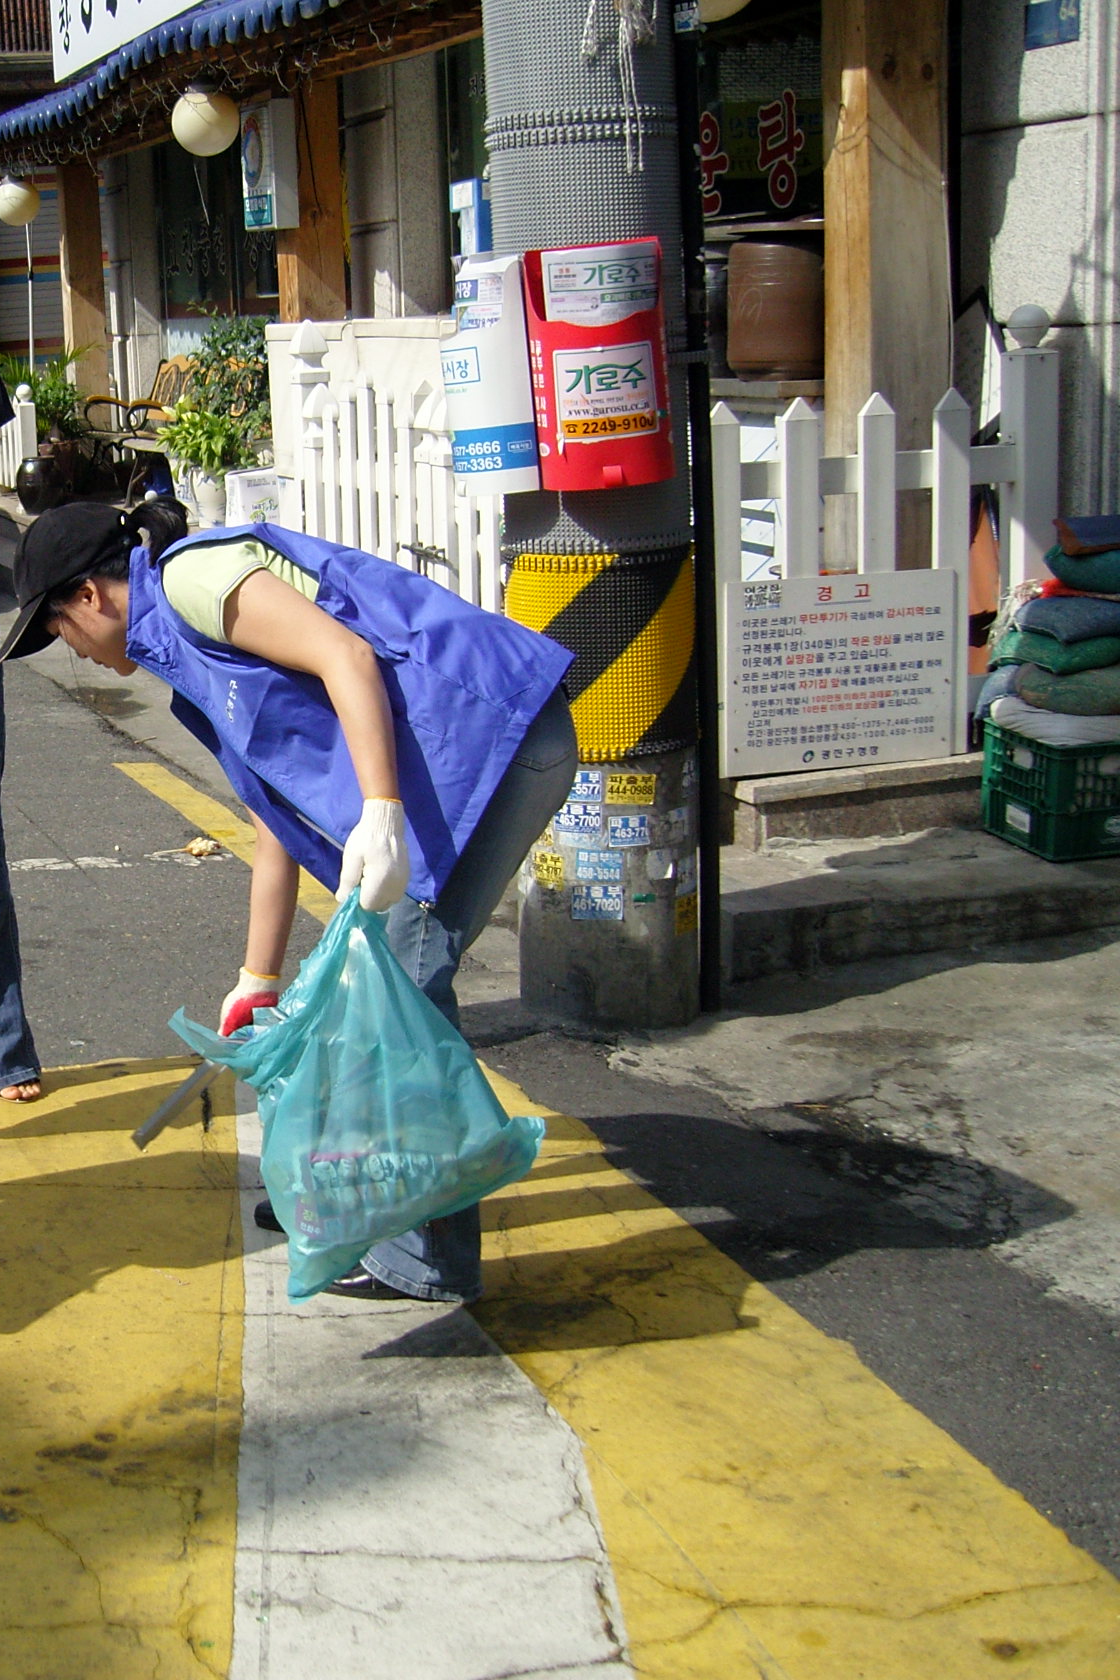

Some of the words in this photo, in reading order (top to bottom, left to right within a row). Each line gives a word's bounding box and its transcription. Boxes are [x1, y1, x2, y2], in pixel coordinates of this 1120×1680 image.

[583, 261, 643, 286] 가로수
[565, 358, 647, 394] 가로수
[800, 612, 848, 624] 무단투기가
[608, 786, 653, 795] 444-0988
[615, 828, 648, 839] 463-77
